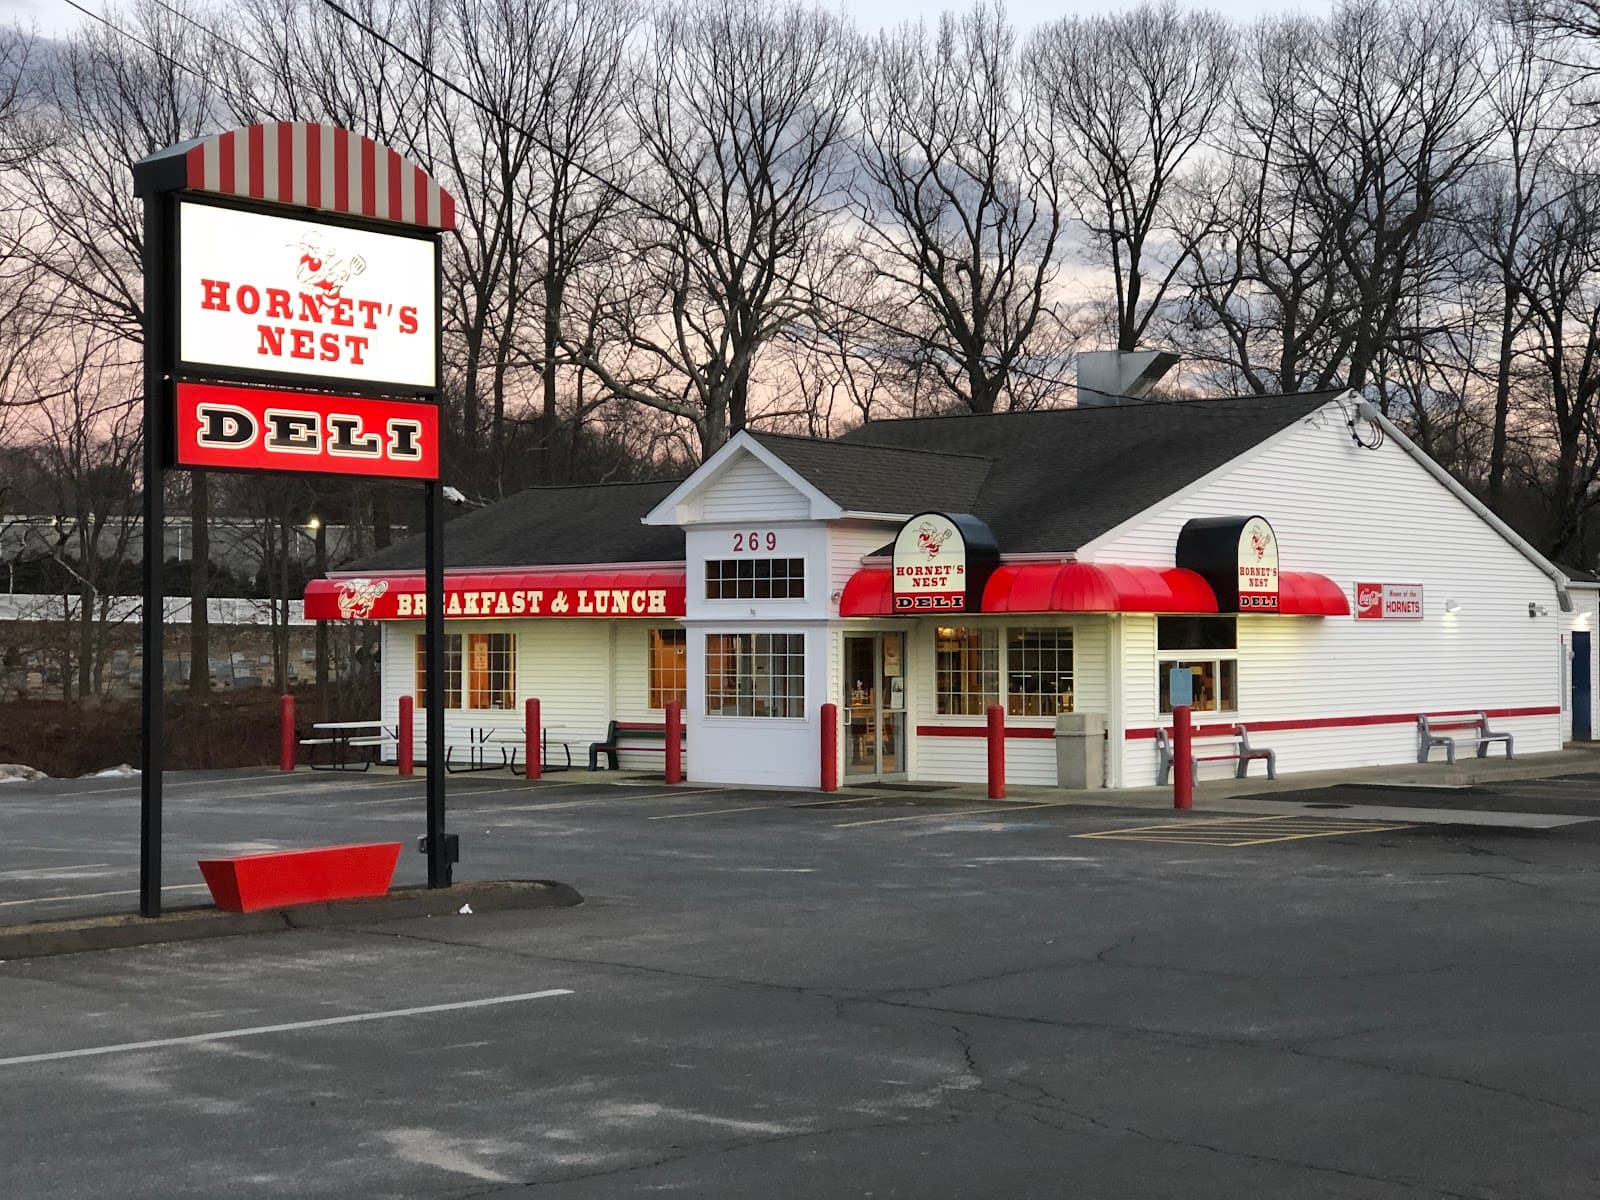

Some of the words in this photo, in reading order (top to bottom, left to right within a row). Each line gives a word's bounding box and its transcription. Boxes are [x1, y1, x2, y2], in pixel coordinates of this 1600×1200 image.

[201, 278, 418, 334] HORNET'S
[257, 324, 369, 365] NEST
[196, 402, 422, 462] DELI
[733, 531, 777, 552] 269
[896, 565, 964, 576] HORNET'S
[1239, 566, 1277, 577] HORNET'S
[912, 577, 948, 587] NEST
[1248, 577, 1269, 588] NEST
[396, 590, 543, 616] BRAKFAST
[550, 590, 570, 613] &
[577, 590, 667, 614] LUNCH
[896, 597, 963, 608] DELI
[1240, 595, 1278, 608] DELI
[1386, 600, 1420, 613] HORNETS
